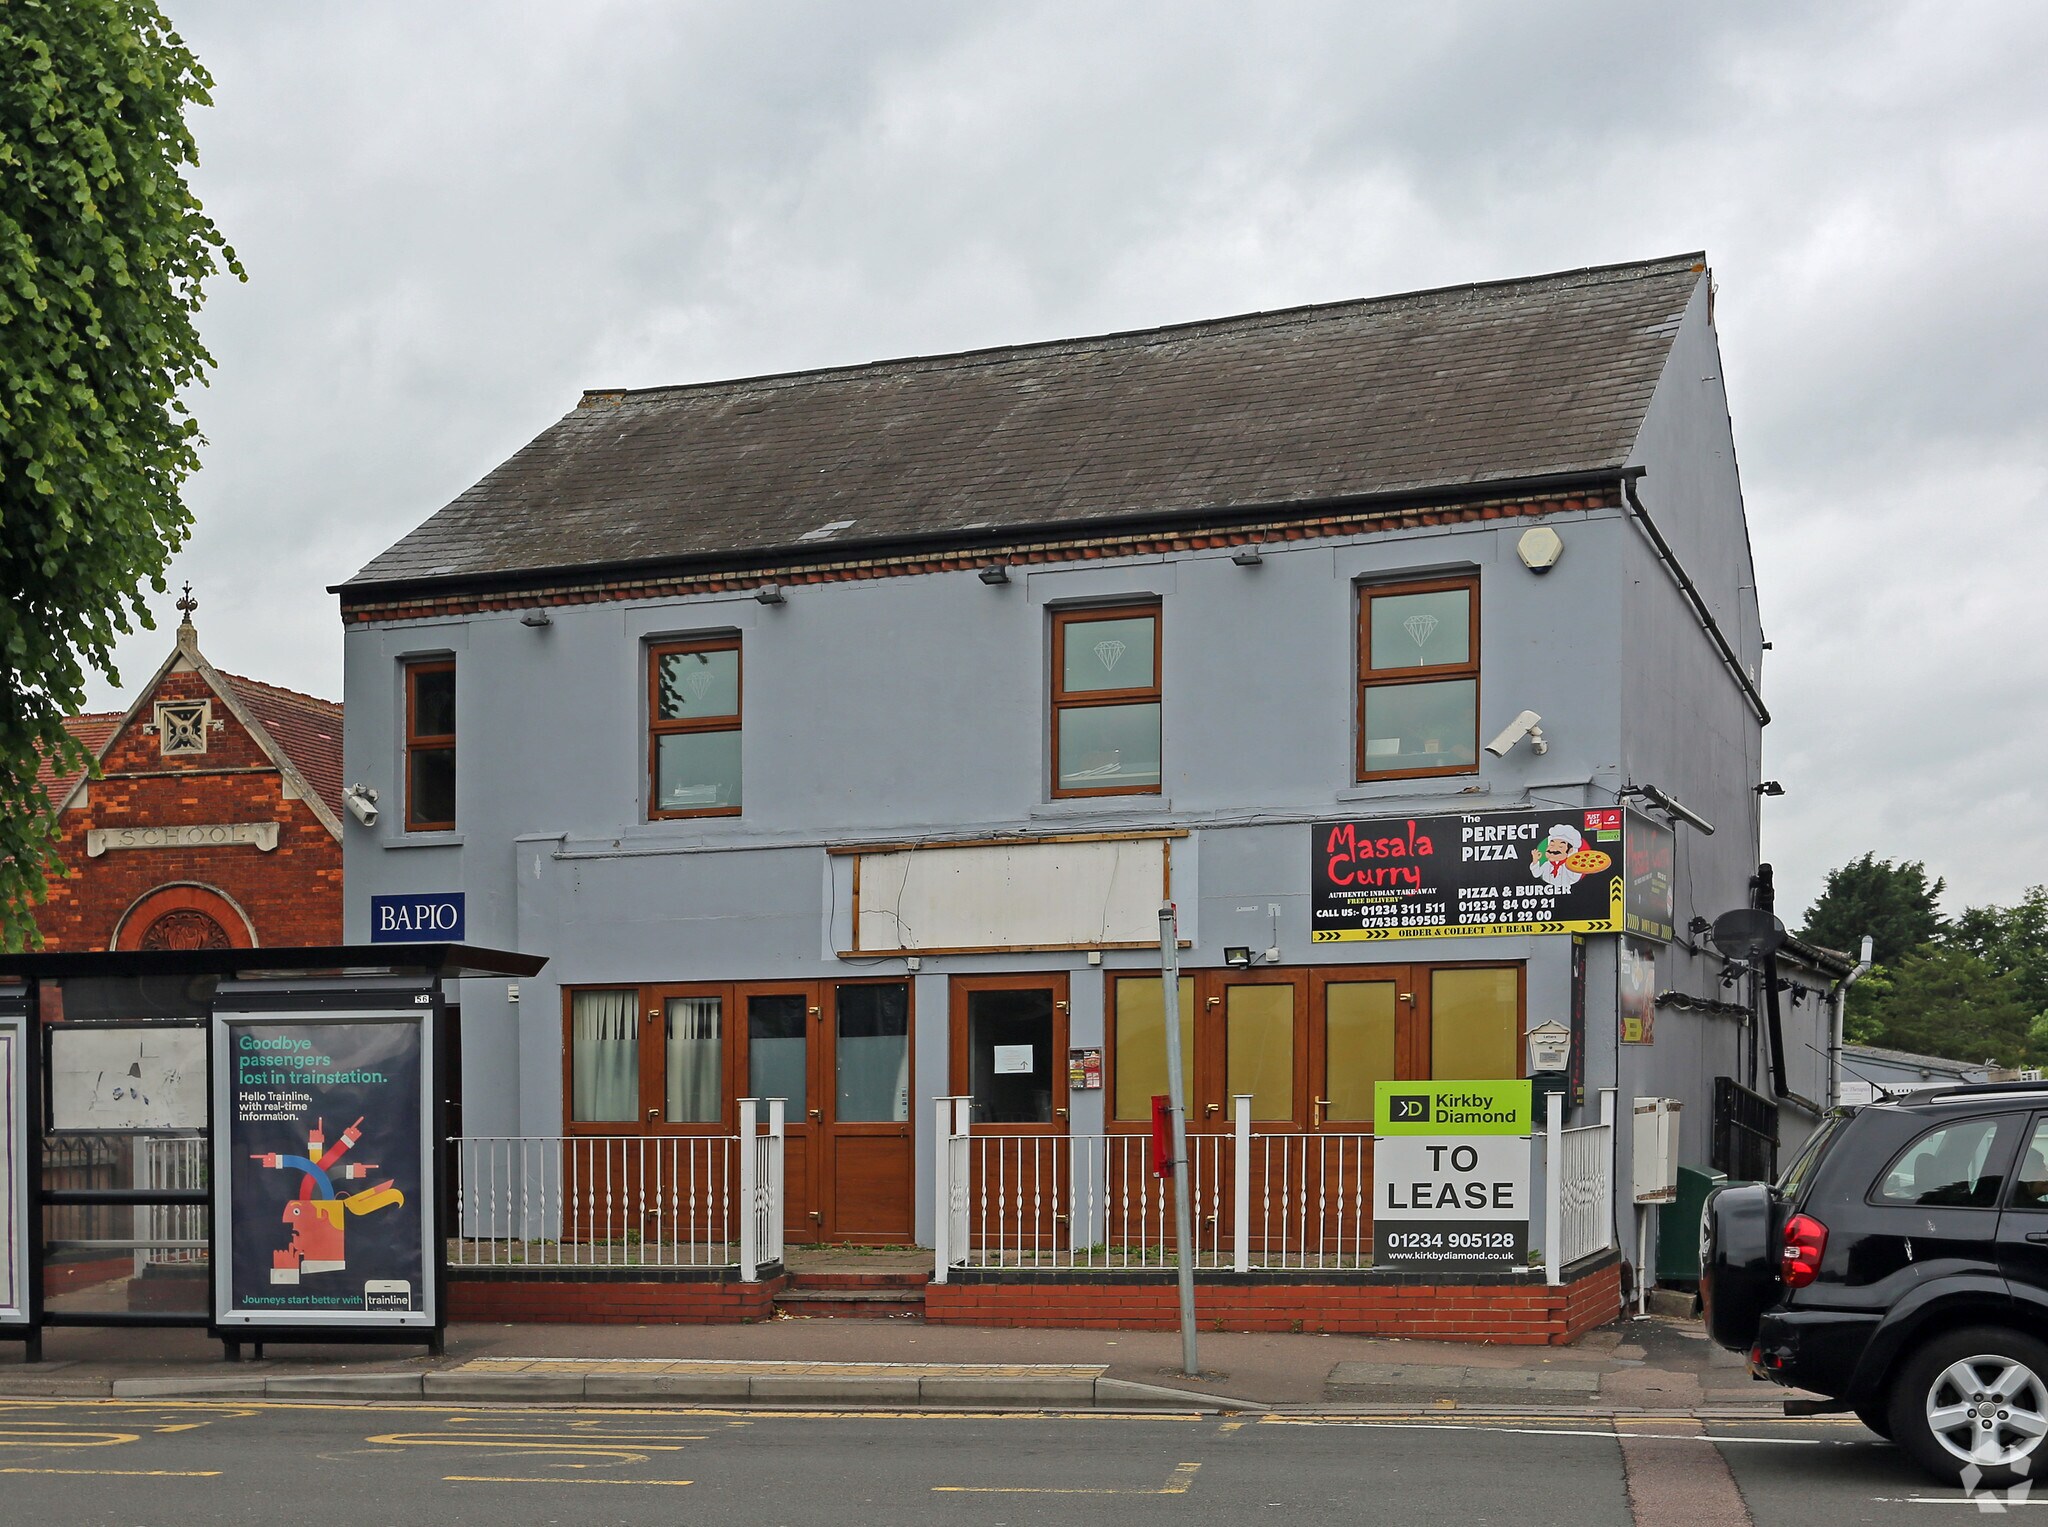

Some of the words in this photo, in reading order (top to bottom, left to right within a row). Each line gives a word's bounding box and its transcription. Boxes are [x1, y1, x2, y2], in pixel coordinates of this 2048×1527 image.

[1461, 815, 1481, 823] The
[119, 826, 246, 846] SCHOOL
[1461, 823, 1540, 843] PERFECT
[1326, 820, 1434, 863] Masala
[1461, 844, 1518, 862] PIZZA
[1327, 853, 1421, 896] Curry
[1328, 890, 1369, 899] AUTHENTIC
[1370, 889, 1395, 897] INDIAN
[1458, 886, 1499, 899] PIZZA
[1502, 886, 1513, 897] &
[1515, 884, 1572, 897] BURGER
[1316, 909, 1341, 918] CALL
[1361, 904, 1398, 916] 01234
[1400, 903, 1422, 914] 311
[1425, 903, 1446, 914] 511
[1458, 900, 1497, 912] 01234
[1503, 899, 1519, 910] 84
[1521, 899, 1538, 909] 09
[1540, 898, 1555, 909] 21
[380, 903, 458, 931] BAPIO
[1362, 916, 1398, 928] 07438
[1401, 915, 1446, 927] 869505
[1458, 912, 1496, 924] 07469
[1499, 912, 1515, 923] 61
[1517, 911, 1534, 921] 22
[1536, 911, 1552, 921] 00
[1398, 927, 1432, 937] ORDER
[1434, 927, 1441, 936] &
[1444, 926, 1486, 936] COLLECT
[1490, 926, 1504, 934] AT
[1506, 925, 1533, 933] REAR
[416, 995, 428, 1003] 56
[239, 1036, 312, 1053] Goodbye
[239, 1055, 331, 1069] passengers
[239, 1069, 268, 1084] lost
[270, 1070, 286, 1084] in
[290, 1069, 387, 1084] trainstation.
[239, 1092, 266, 1101] Hello
[268, 1091, 313, 1103] Trainline,
[1436, 1094, 1493, 1110] Kirkby
[239, 1102, 262, 1111] with
[264, 1101, 308, 1111] real-time
[239, 1111, 300, 1121] information.
[1436, 1110, 1516, 1124] Diamond
[1426, 1145, 1479, 1173] TO
[1388, 1182, 1514, 1209] LEASE
[1388, 1233, 1443, 1248] 01234
[1448, 1233, 1515, 1248] 905128
[1388, 1252, 1515, 1261] www.kirkbydiamond.co.uk
[242, 1295, 285, 1306] Journeys
[288, 1296, 310, 1304] start
[312, 1295, 341, 1304] better
[342, 1295, 363, 1304] with
[368, 1294, 408, 1305] trainline
[314, 1417, 754, 1469] BUS
